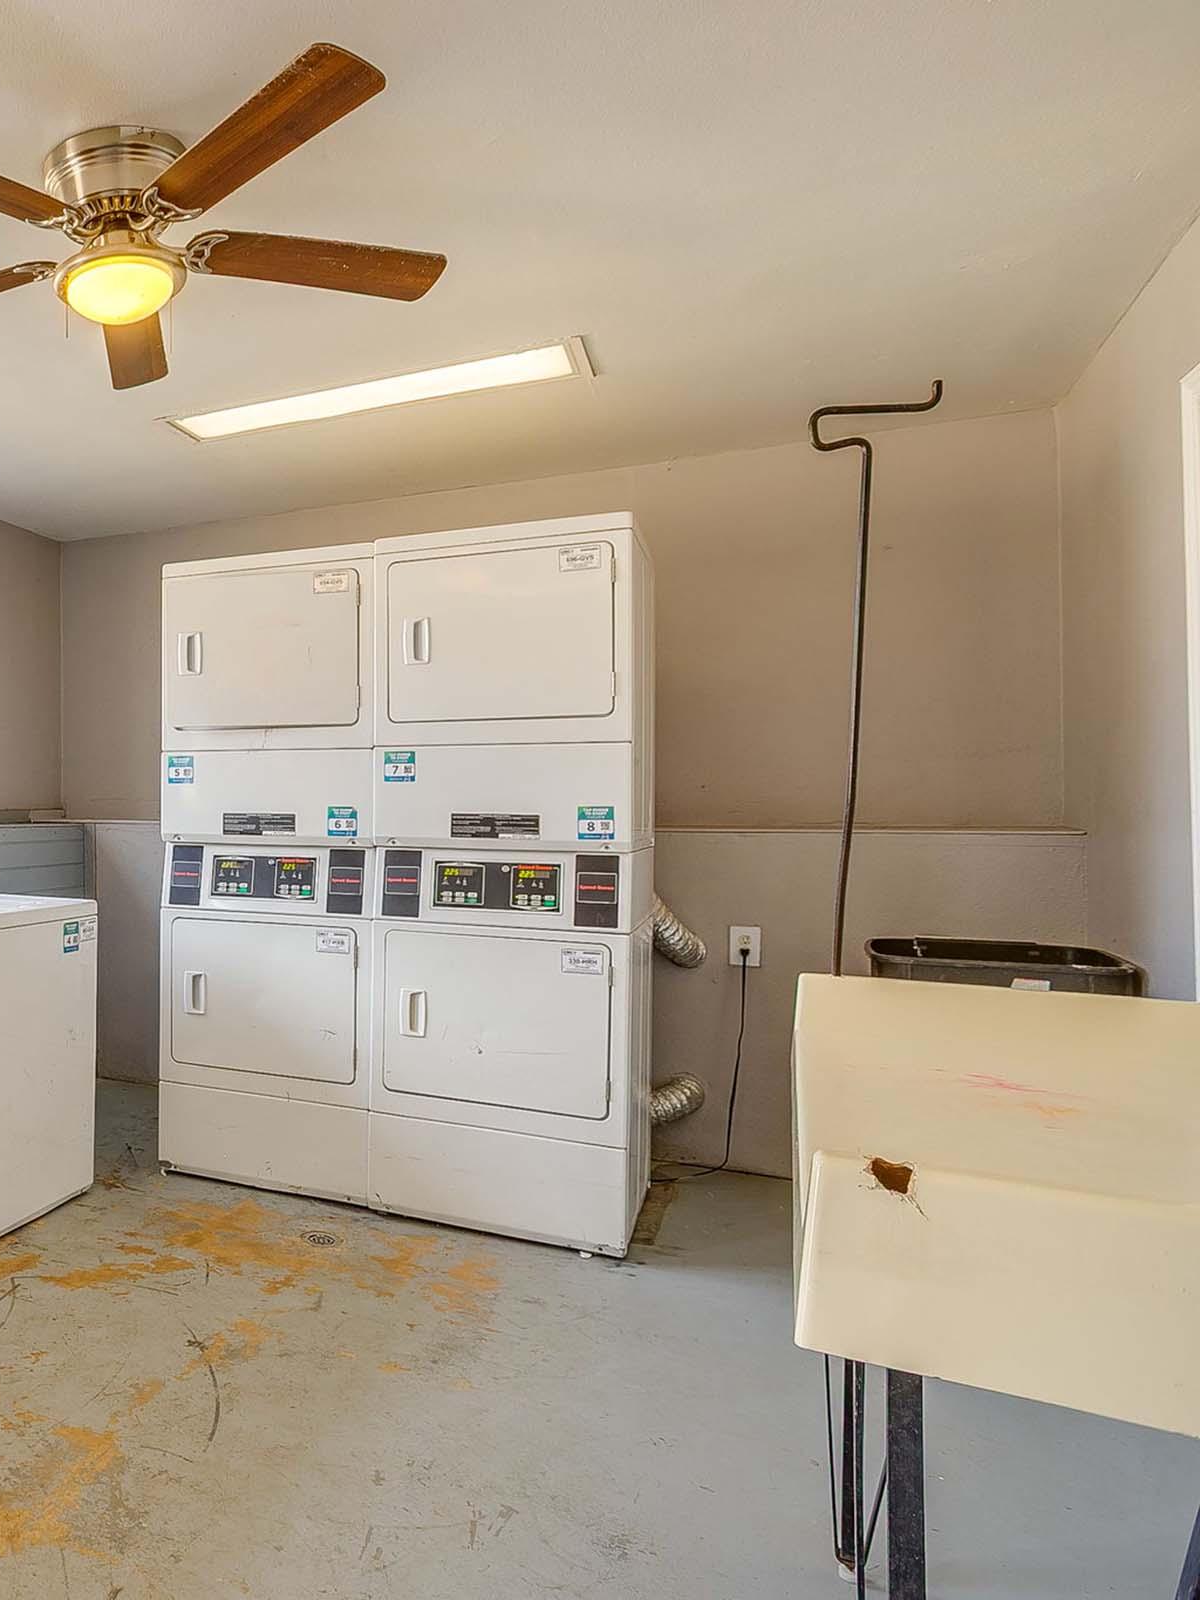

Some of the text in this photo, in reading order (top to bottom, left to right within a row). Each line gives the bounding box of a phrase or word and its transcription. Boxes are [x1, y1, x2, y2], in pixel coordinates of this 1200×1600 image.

[174, 768, 180, 776] 5
[392, 765, 398, 774] 7
[335, 820, 341, 828] 6
[587, 822, 595, 832] 8
